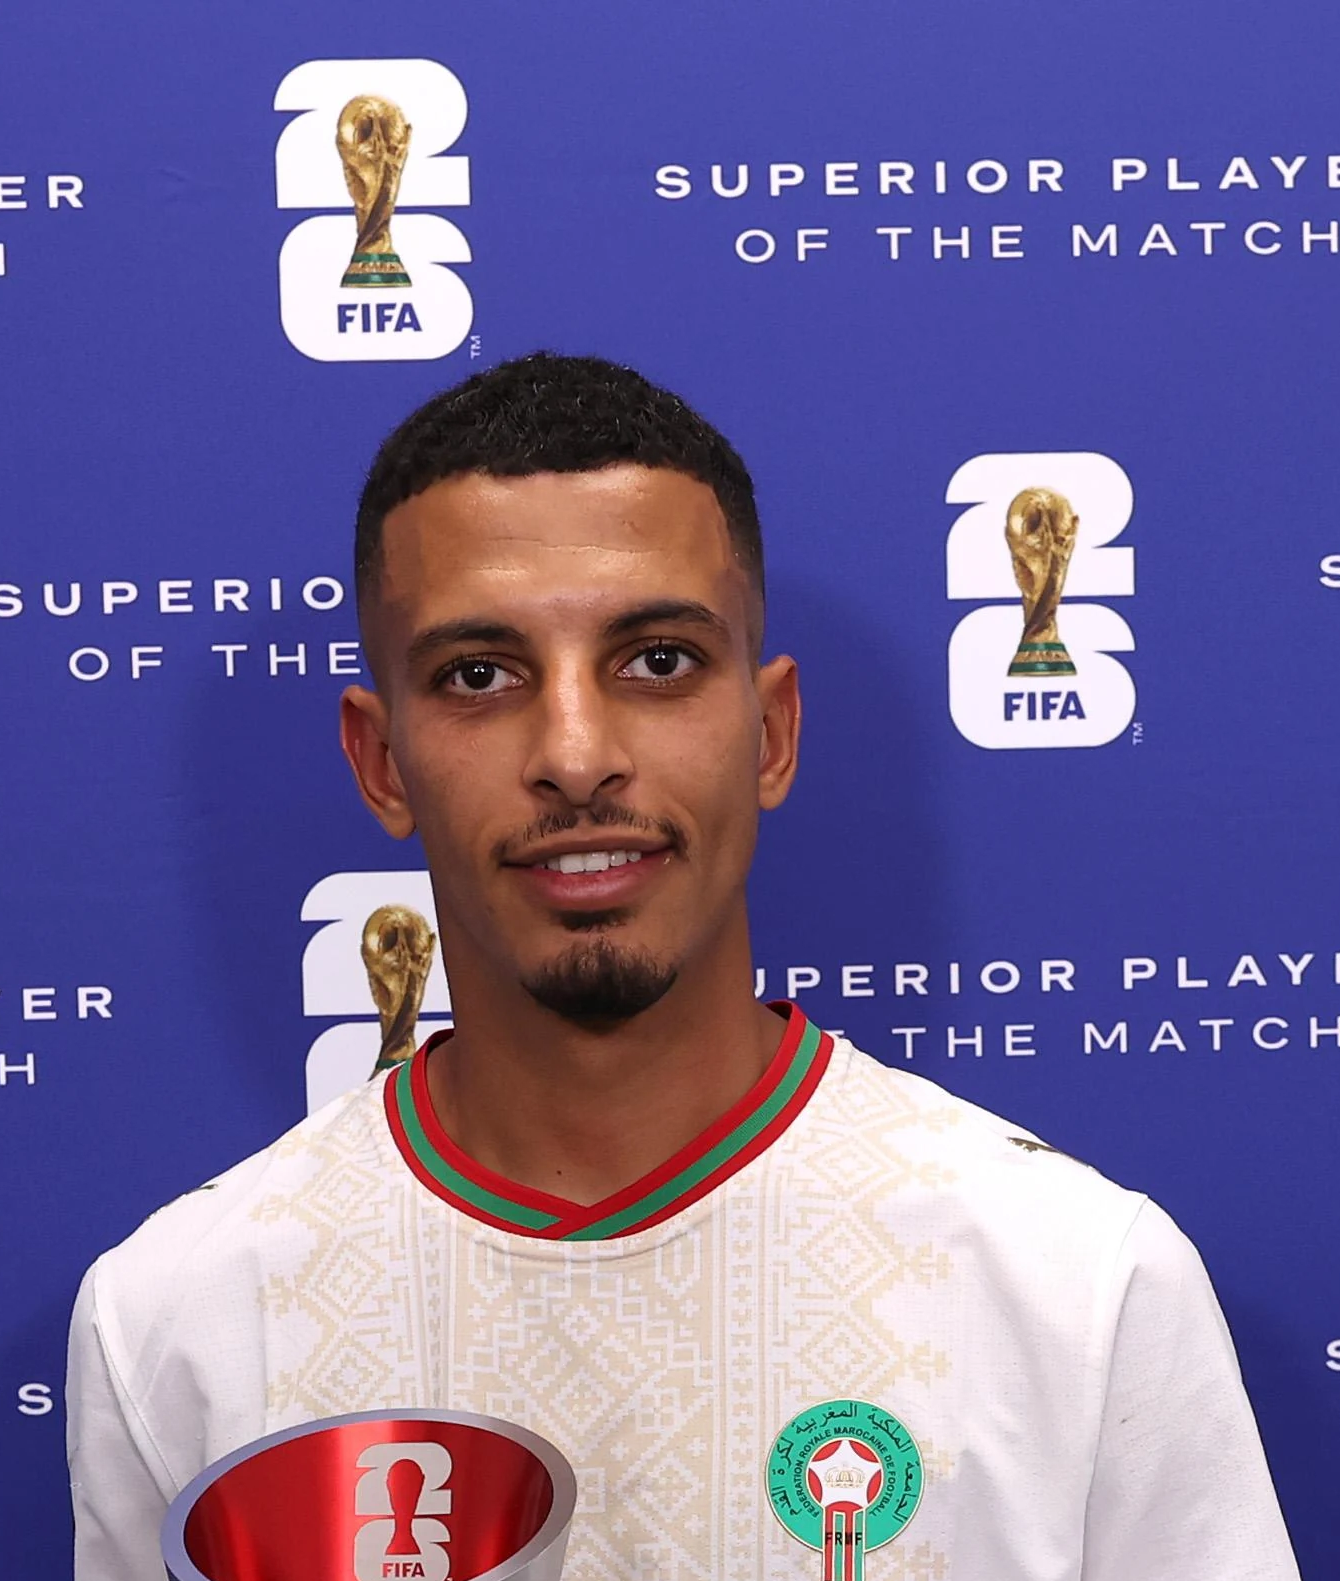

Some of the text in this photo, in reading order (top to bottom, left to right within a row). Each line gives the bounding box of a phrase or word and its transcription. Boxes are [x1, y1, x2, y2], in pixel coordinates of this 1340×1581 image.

[654, 159, 1064, 200] SUPERIOR
[734, 220, 1339, 264] OF THE MATCH
[337, 302, 423, 334] FIFA
[68, 641, 362, 682] OF THE
[1003, 690, 1086, 722] FIFA
[754, 960, 1076, 999] PERIOR
[891, 1023, 1037, 1059] THE
[799, 1429, 831, 1459] ROYALE
[833, 1426, 888, 1454] MAROCAINE
[884, 1454, 895, 1470] DE
[793, 1459, 820, 1518] FEDERATION
[381, 1562, 426, 1579] FIFA
